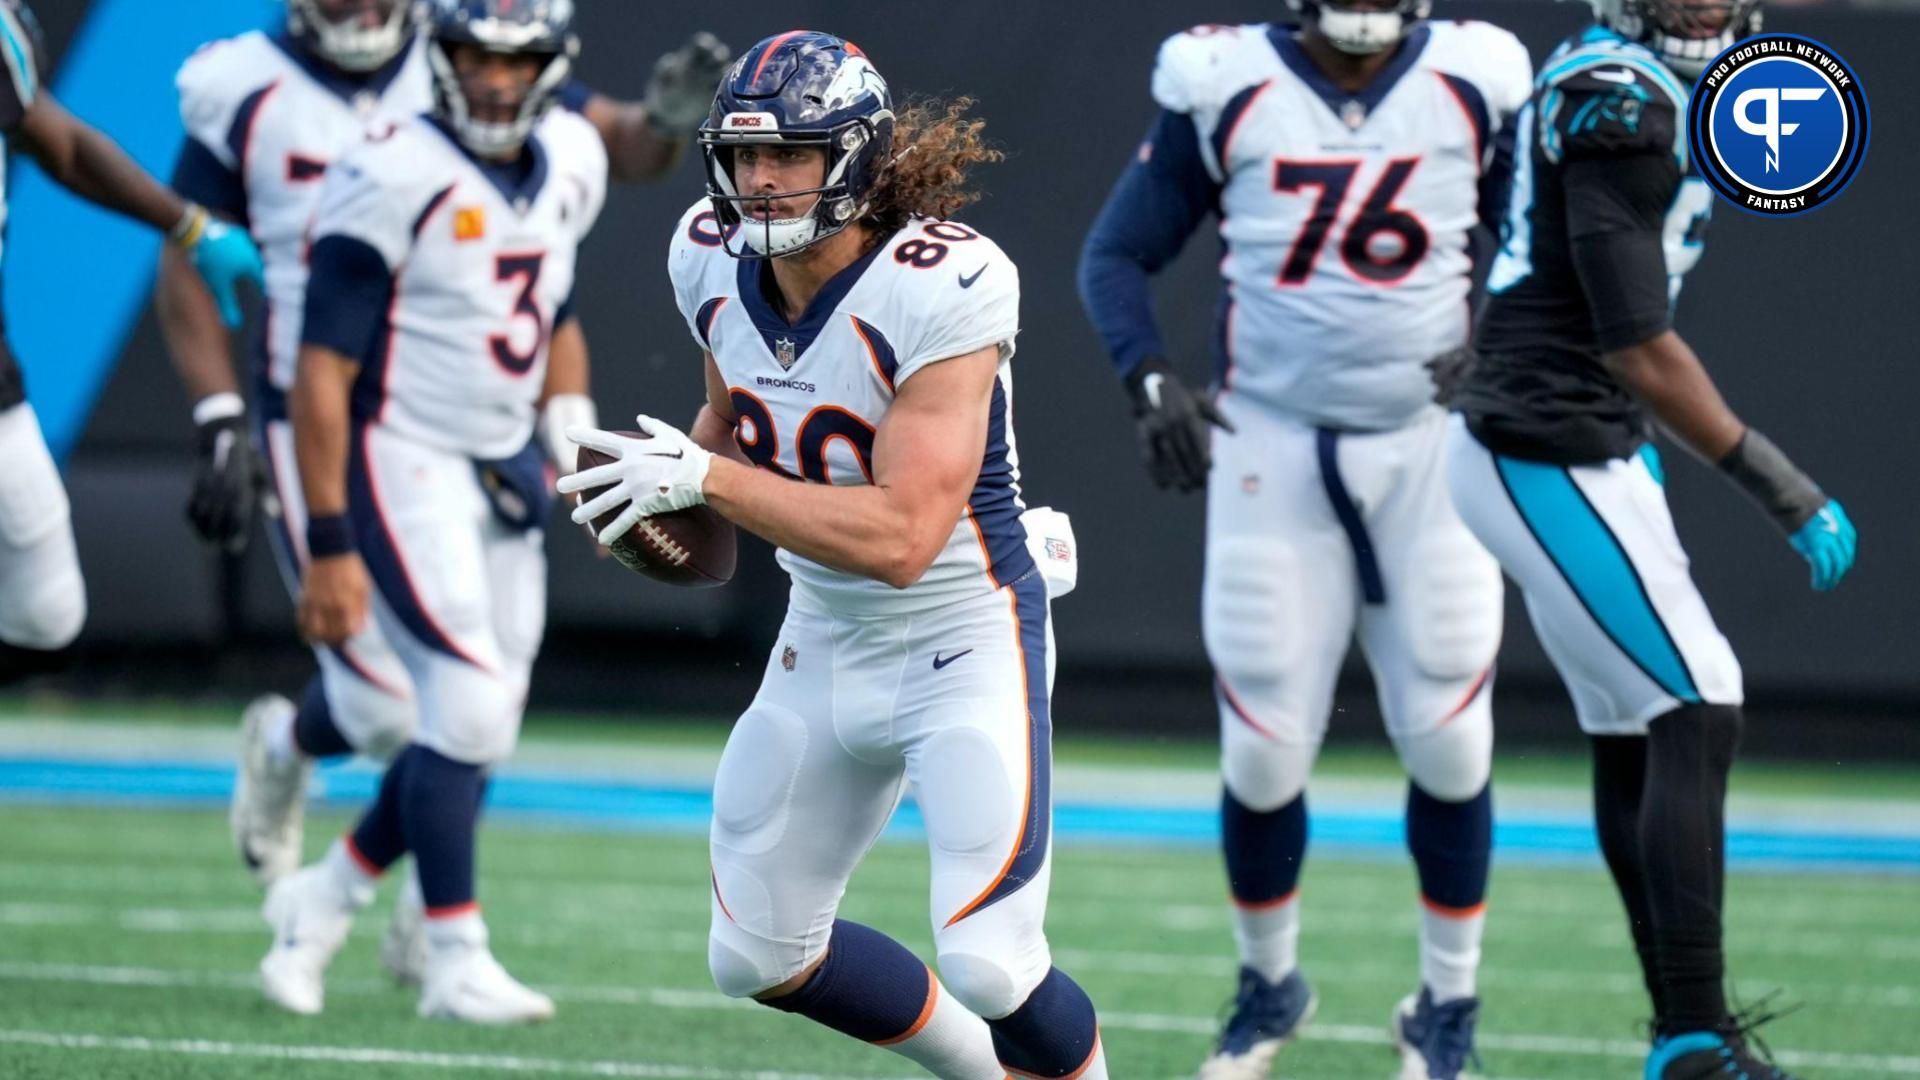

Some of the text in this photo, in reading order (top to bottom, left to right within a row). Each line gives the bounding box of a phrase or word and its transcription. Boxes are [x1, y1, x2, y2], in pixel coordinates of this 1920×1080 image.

[731, 117, 761, 127] BRONCOS
[1271, 154, 1431, 289] 76
[892, 223, 979, 269] 80
[486, 250, 547, 378] 3
[756, 376, 816, 393] BRONCOS
